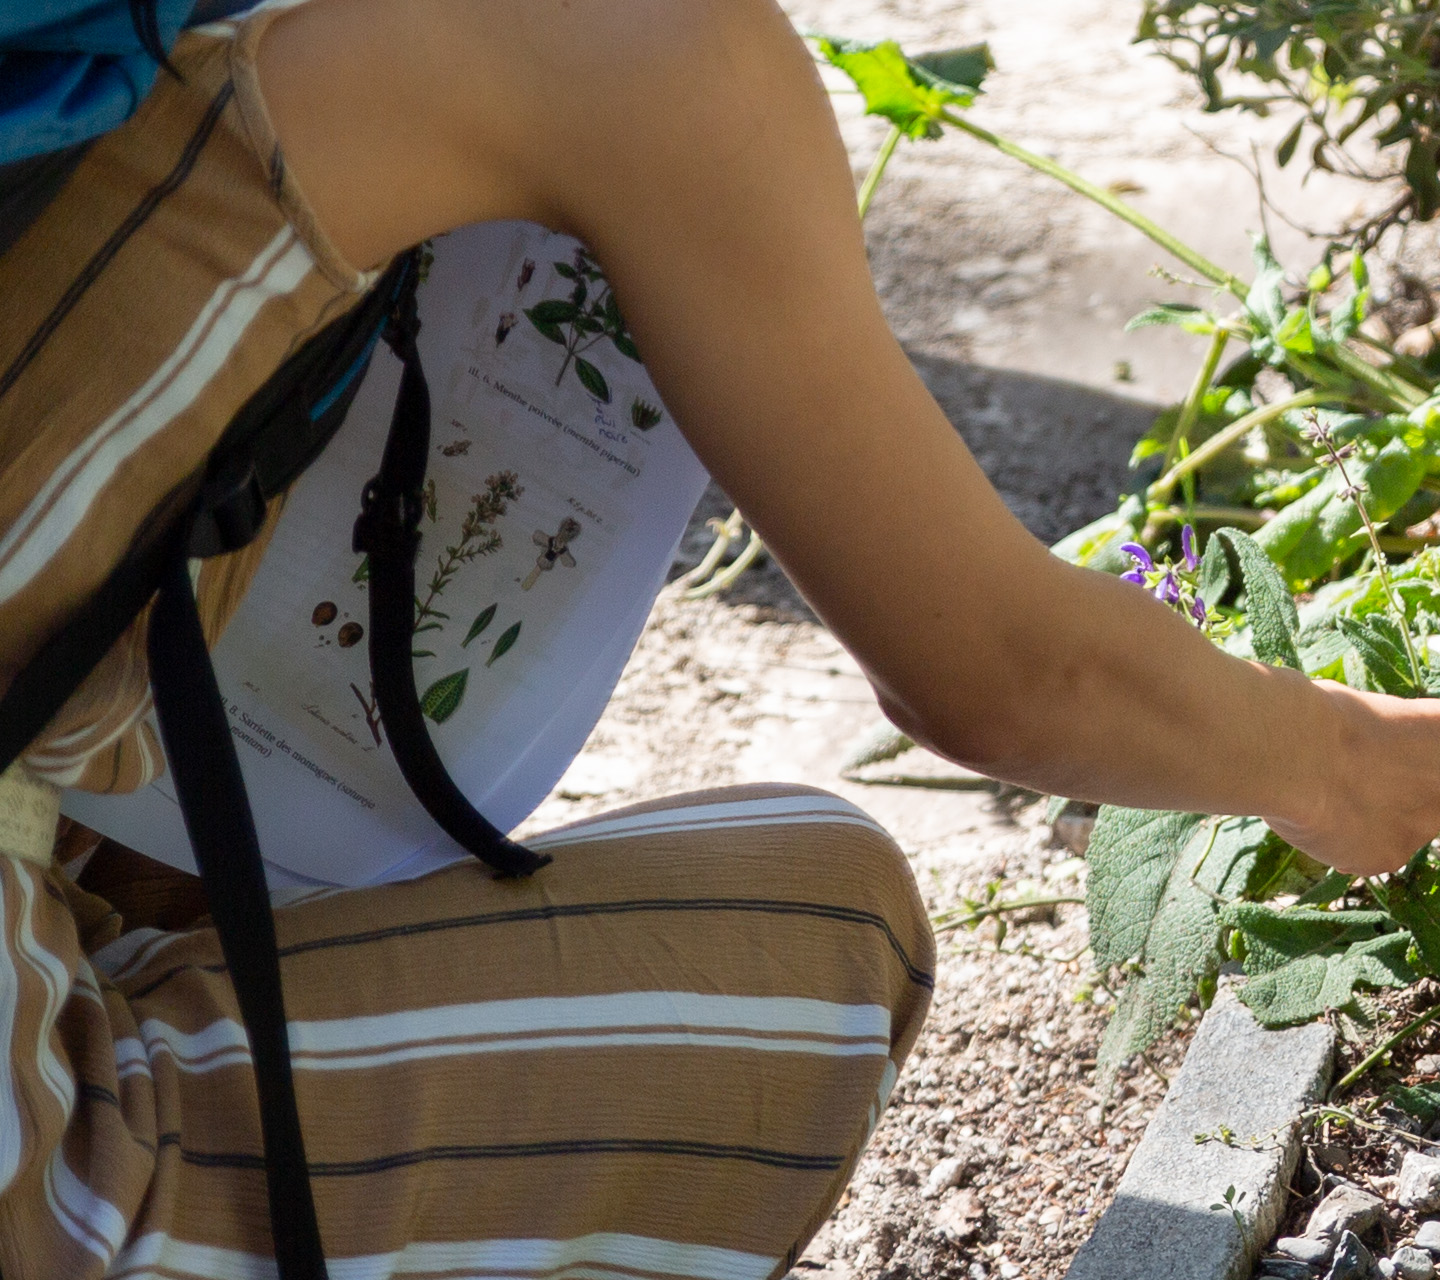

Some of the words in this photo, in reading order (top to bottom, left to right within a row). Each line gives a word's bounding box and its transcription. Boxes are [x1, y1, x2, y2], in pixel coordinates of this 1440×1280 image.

[493, 381, 527, 406] Menthe
[528, 404, 563, 428] poivrée
[231, 725, 273, 758] montana)
[239, 712, 276, 743] Sarriette
[276, 739, 292, 755] des
[291, 751, 338, 787] montagnes
